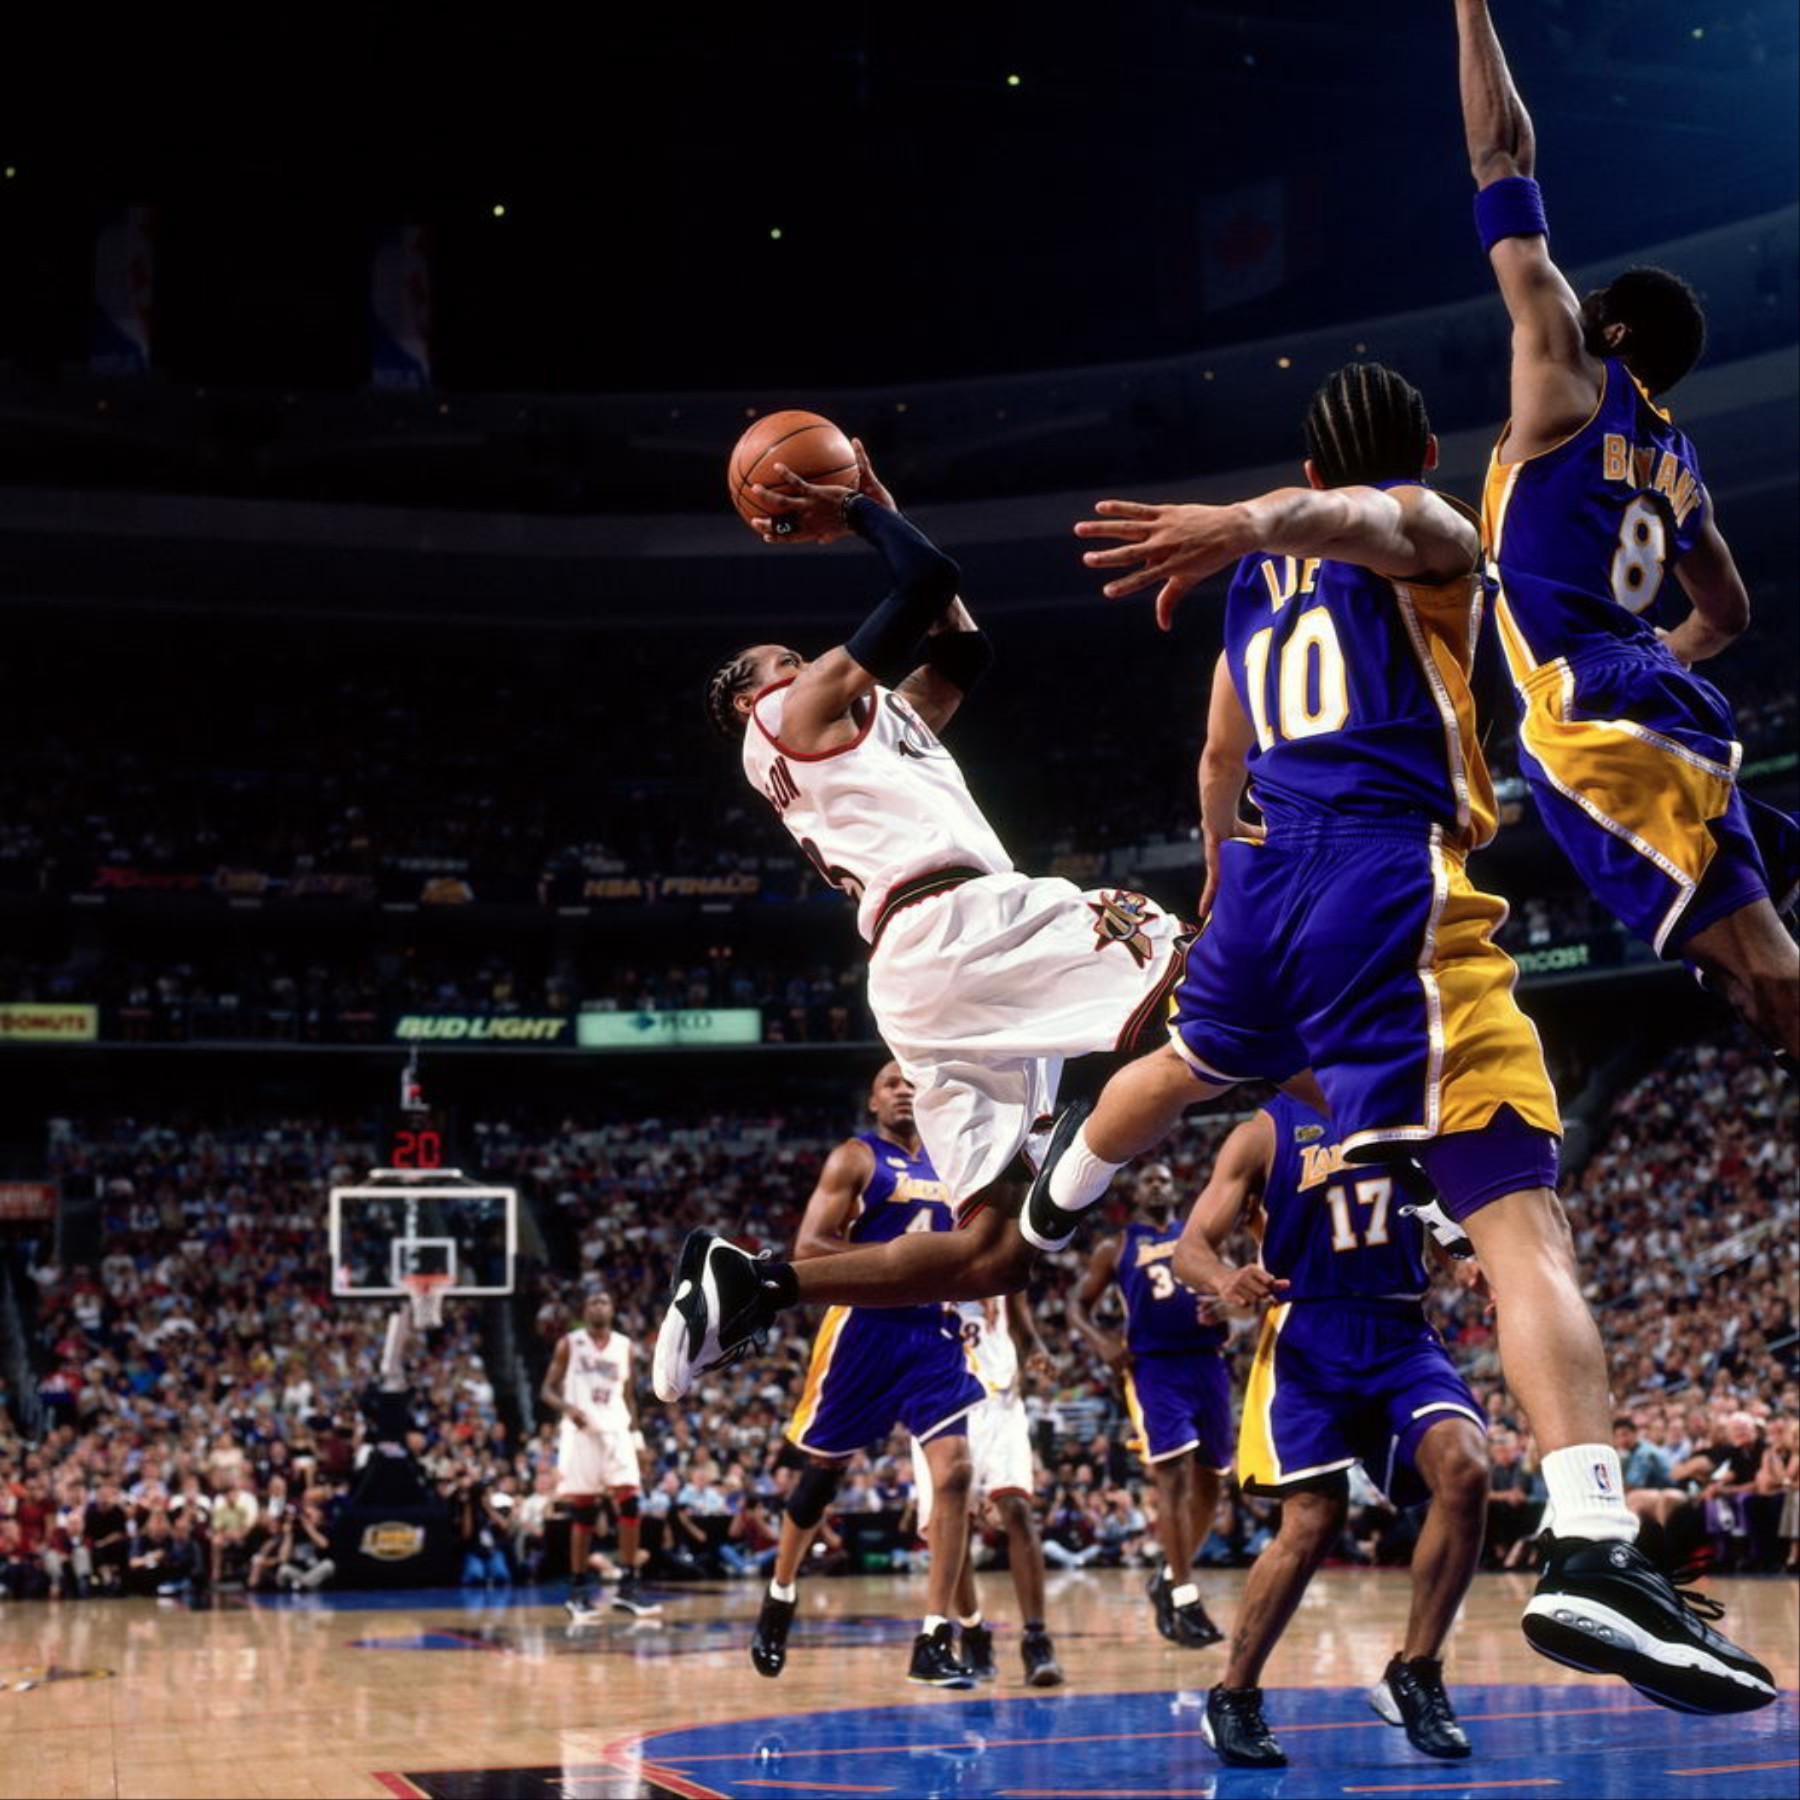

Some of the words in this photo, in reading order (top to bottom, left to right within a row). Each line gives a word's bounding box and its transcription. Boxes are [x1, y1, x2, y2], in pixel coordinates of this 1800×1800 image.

[1611, 494, 1665, 614] 8
[1245, 605, 1350, 753] 10
[395, 1015, 467, 1040] BUD
[467, 1016, 568, 1040] LIGHT
[390, 1130, 443, 1168] 20
[1326, 1177, 1393, 1253] 17
